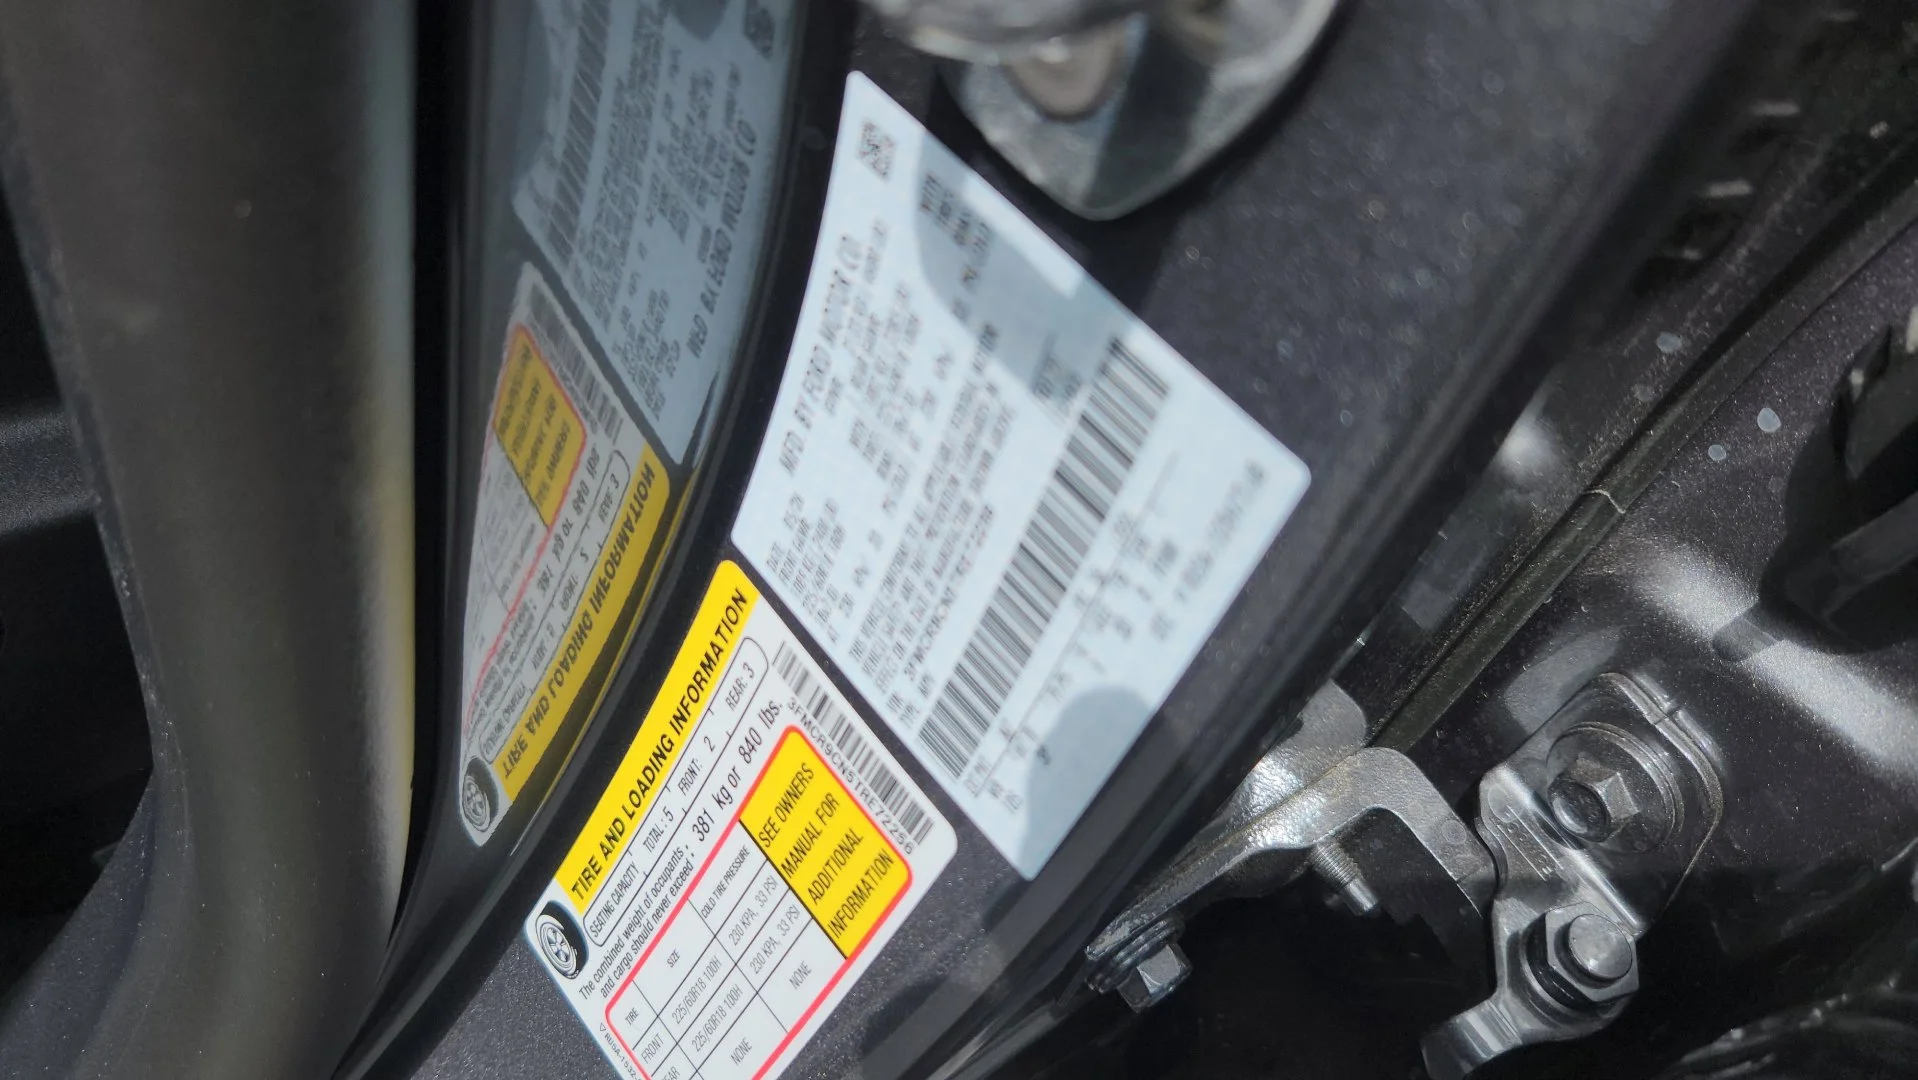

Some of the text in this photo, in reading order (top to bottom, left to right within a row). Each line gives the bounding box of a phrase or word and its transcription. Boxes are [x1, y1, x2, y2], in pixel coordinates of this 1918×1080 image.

[723, 660, 755, 712] REAR: 3
[571, 585, 748, 903] TIRE AND LOADING INFORMATION
[676, 733, 716, 796] FRONT: 2
[690, 807, 715, 843] 381
[710, 780, 734, 813] kg
[725, 763, 743, 789] or
[737, 724, 763, 765] 840
[756, 691, 783, 729] lbs.
[661, 804, 674, 823] 5
[757, 760, 815, 849] SEE OWNERS
[780, 790, 840, 879] MANUAL FOR
[588, 860, 640, 939] SEATING CAPACITY
[700, 844, 750, 919] COLD TIRE PRESSURE
[805, 823, 864, 905] ADDITIONAL
[827, 847, 895, 939] INFORMATION
[578, 843, 684, 1001] The combined weight of occupants
[599, 857, 694, 999] and cargo should never exceed
[727, 922, 745, 947] 230
[753, 888, 769, 908] 33
[762, 873, 778, 896] PSI
[748, 950, 766, 975] 230
[775, 917, 791, 937] 33
[783, 902, 801, 926] PSI
[666, 947, 681, 969] SIZE
[670, 954, 722, 1027] 225/60R18 100H
[788, 959, 812, 990] NONE
[624, 1006, 639, 1027] TIRE
[640, 1031, 665, 1065] FRONT
[690, 982, 743, 1053] 225/60R18 100H
[729, 1036, 752, 1066] NONE
